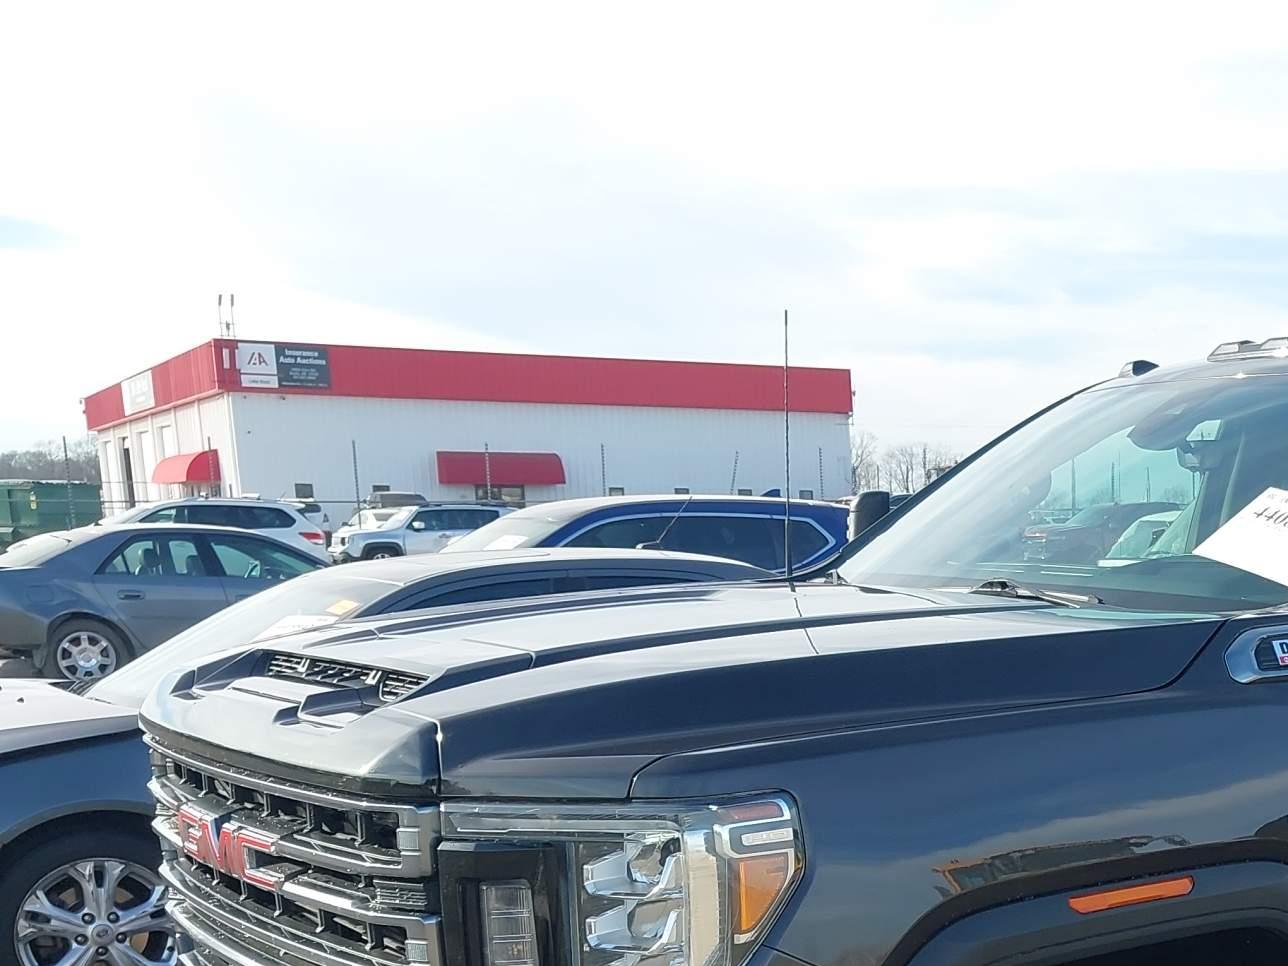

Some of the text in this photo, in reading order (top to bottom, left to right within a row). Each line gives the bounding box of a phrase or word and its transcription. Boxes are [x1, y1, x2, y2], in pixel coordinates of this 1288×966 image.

[285, 348, 318, 356] Insurance
[280, 355, 326, 365] Auto Auctions
[178, 803, 285, 892] GMC
